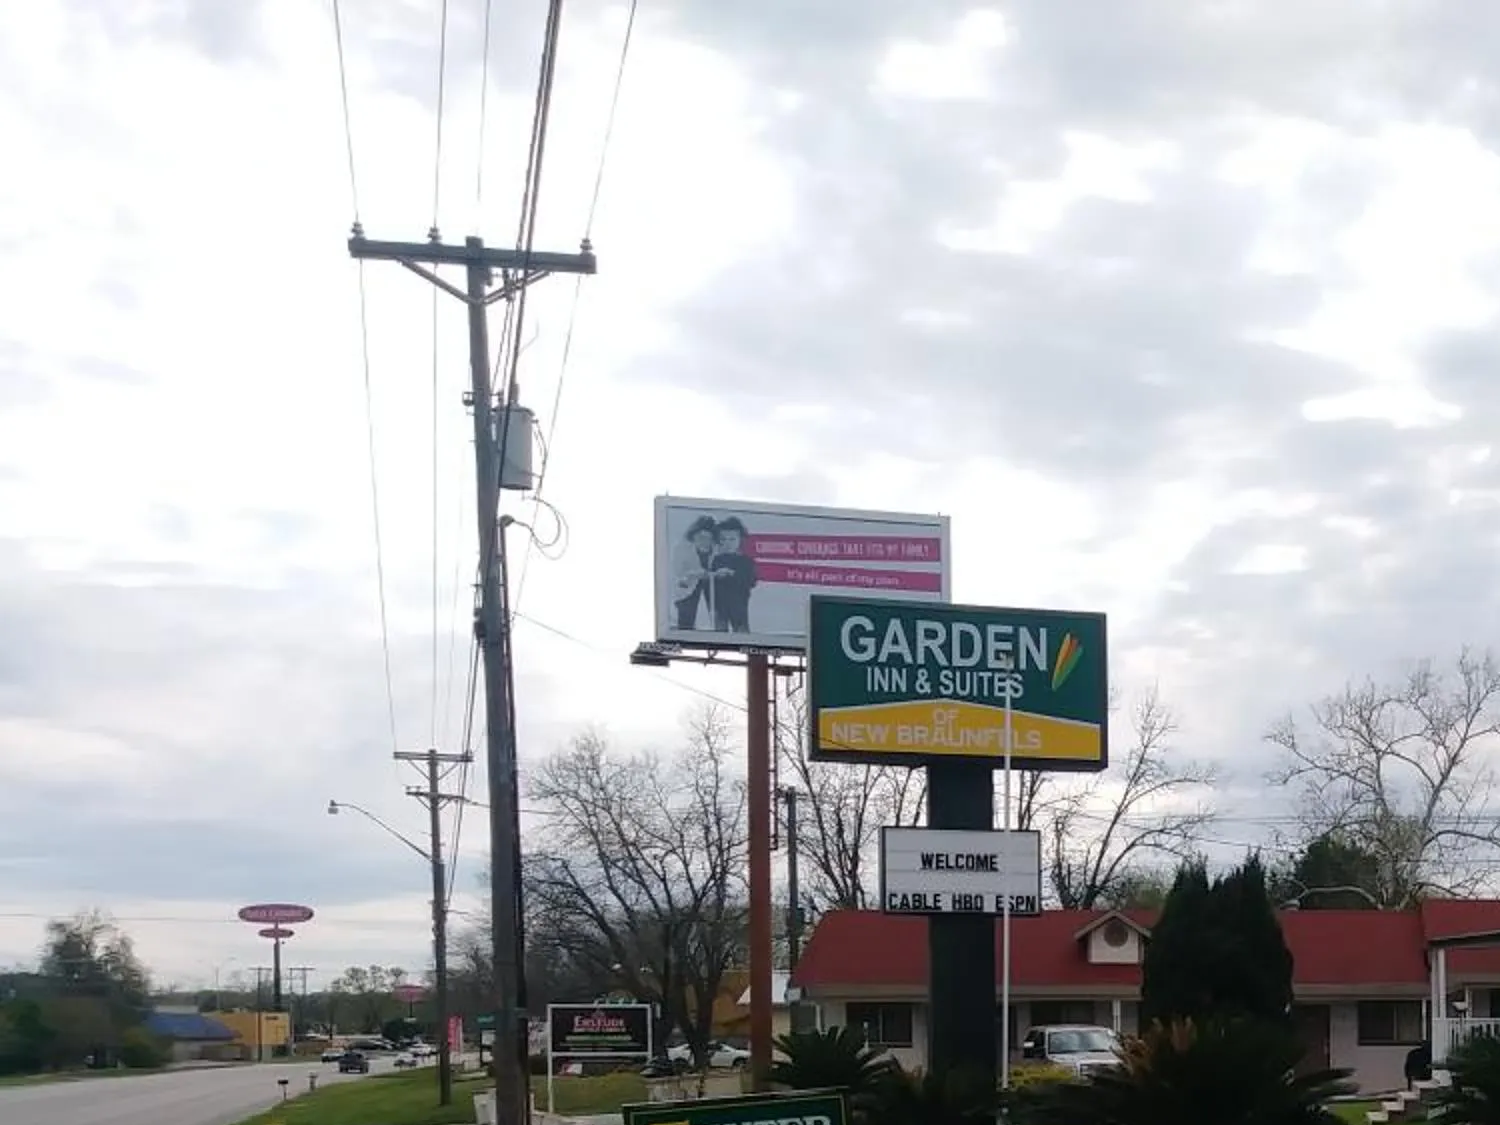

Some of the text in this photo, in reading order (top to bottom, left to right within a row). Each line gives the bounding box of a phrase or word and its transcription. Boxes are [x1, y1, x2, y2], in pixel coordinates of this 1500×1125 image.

[840, 615, 1048, 672] GARDEN
[867, 666, 1025, 698] INN & SUITES
[932, 708, 959, 725] OF
[831, 722, 1042, 750] NEW BRAUNFLS
[920, 852, 999, 873] WELCOME
[888, 892, 1036, 913] CABLE HBO ESPN
